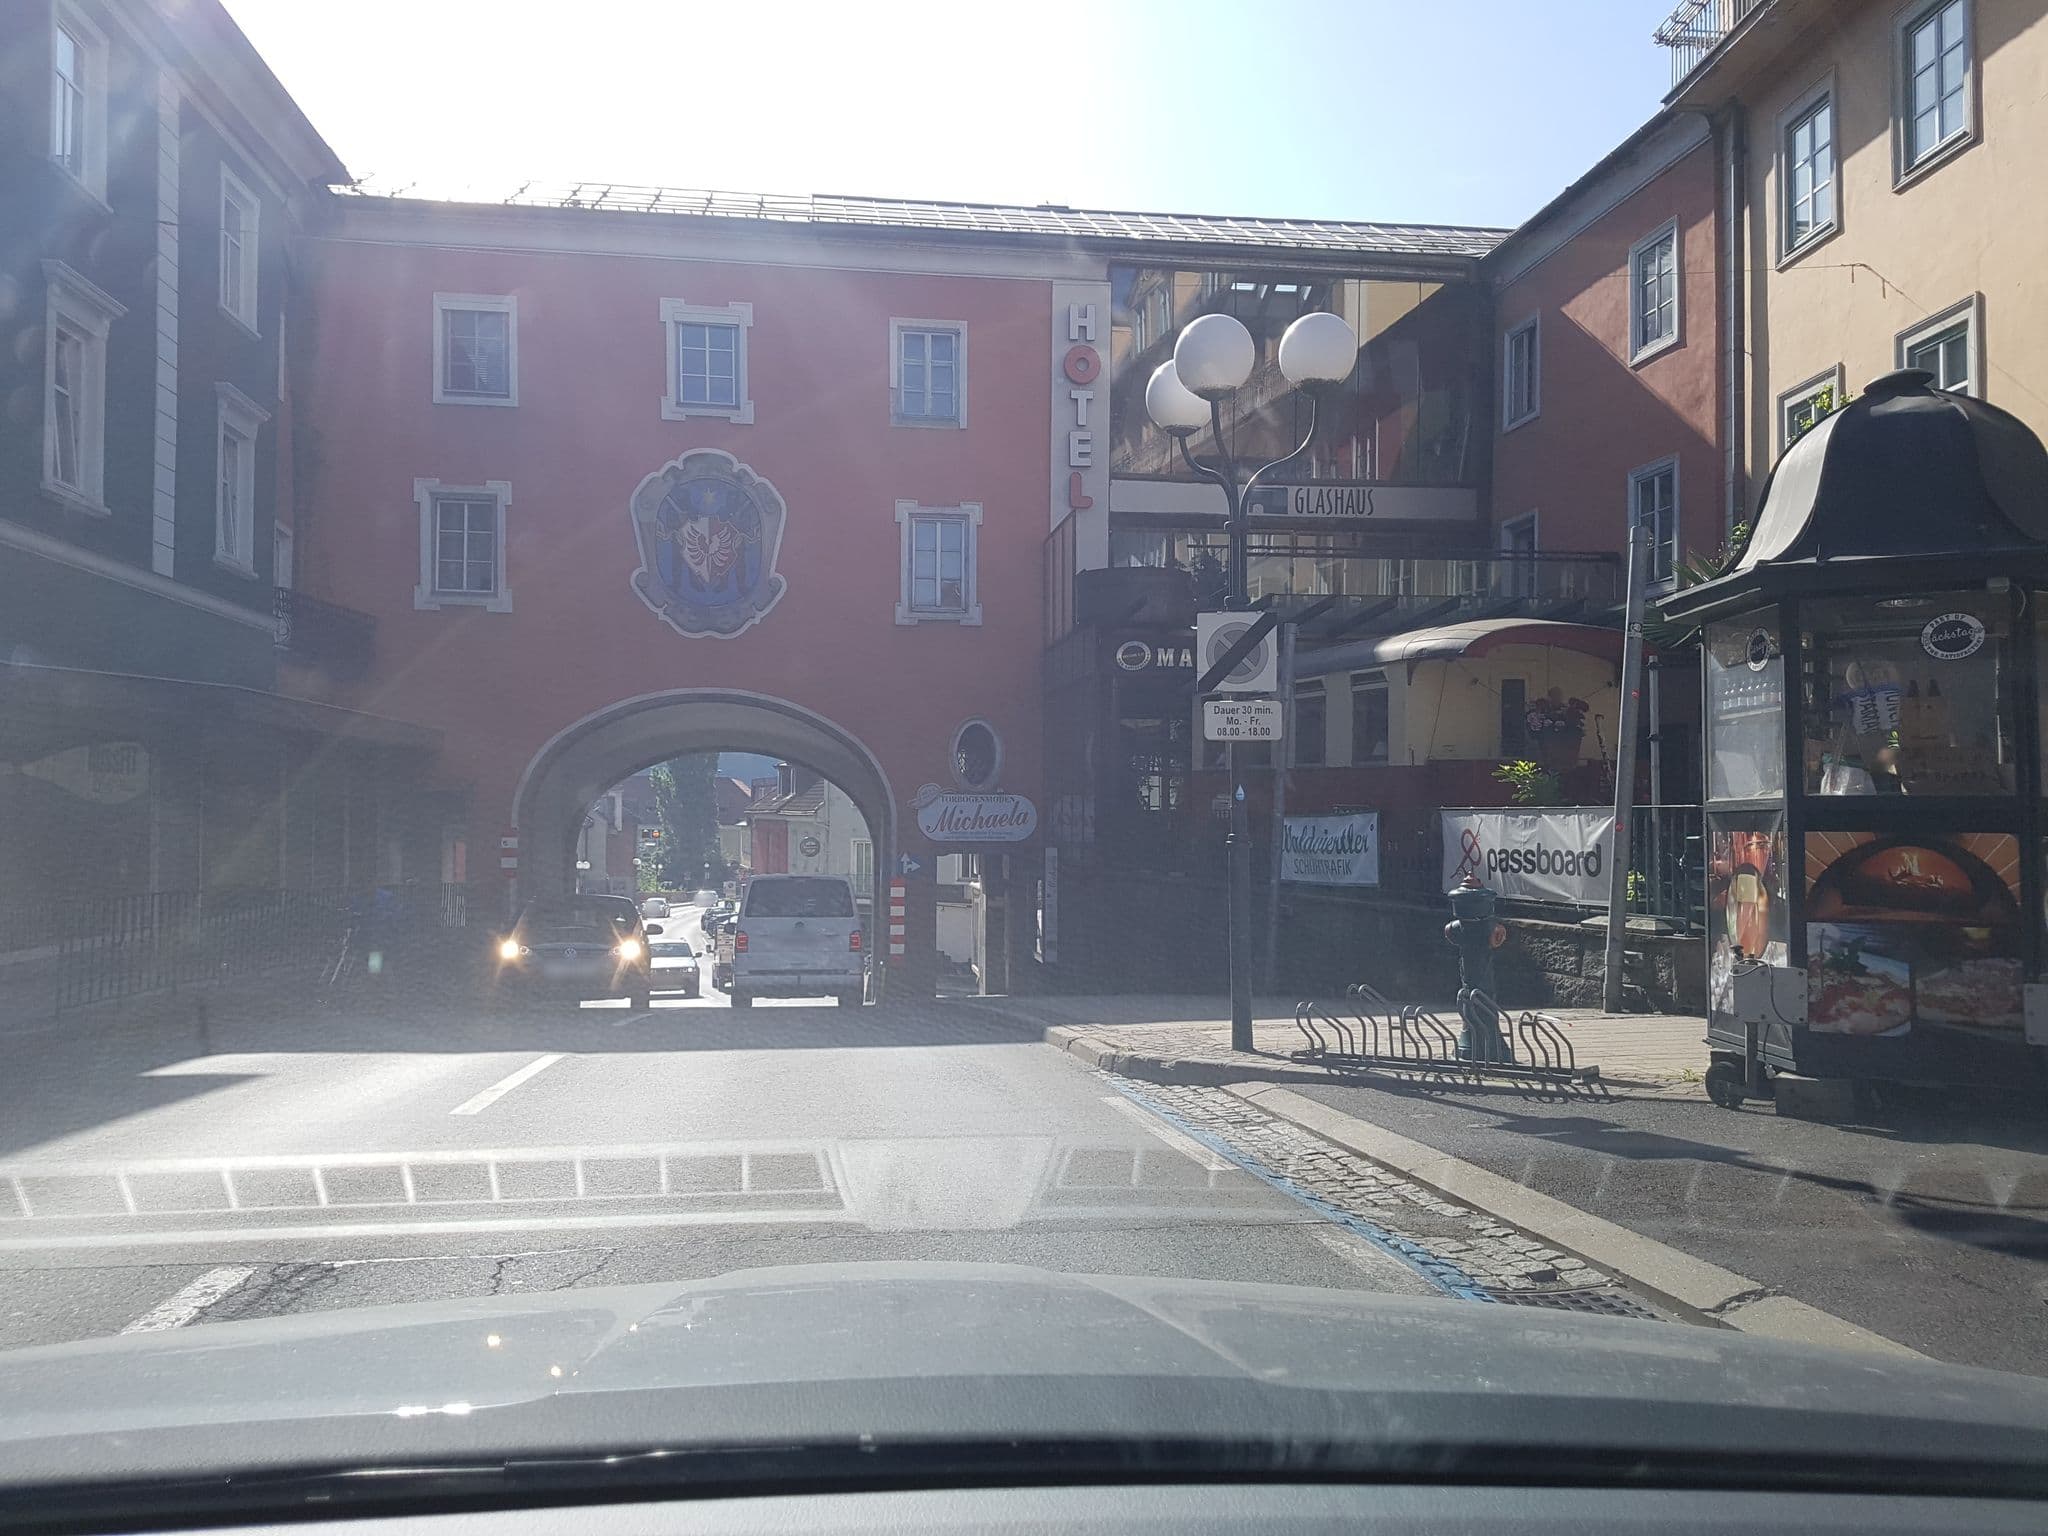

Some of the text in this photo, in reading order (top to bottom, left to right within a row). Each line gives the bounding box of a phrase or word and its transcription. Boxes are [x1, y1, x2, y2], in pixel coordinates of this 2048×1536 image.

[1064, 304, 1101, 508] HOTEL
[1295, 487, 1374, 516] GLASHAUS
[1213, 704, 1273, 715] Dauer 30 min.
[1226, 716, 1242, 726] Mo.
[1249, 716, 1261, 726] Fr.
[1216, 727, 1240, 737] 08.00
[1247, 727, 1271, 737] 18.00
[926, 800, 1030, 834] Michaela
[1486, 842, 1602, 881] passboard
